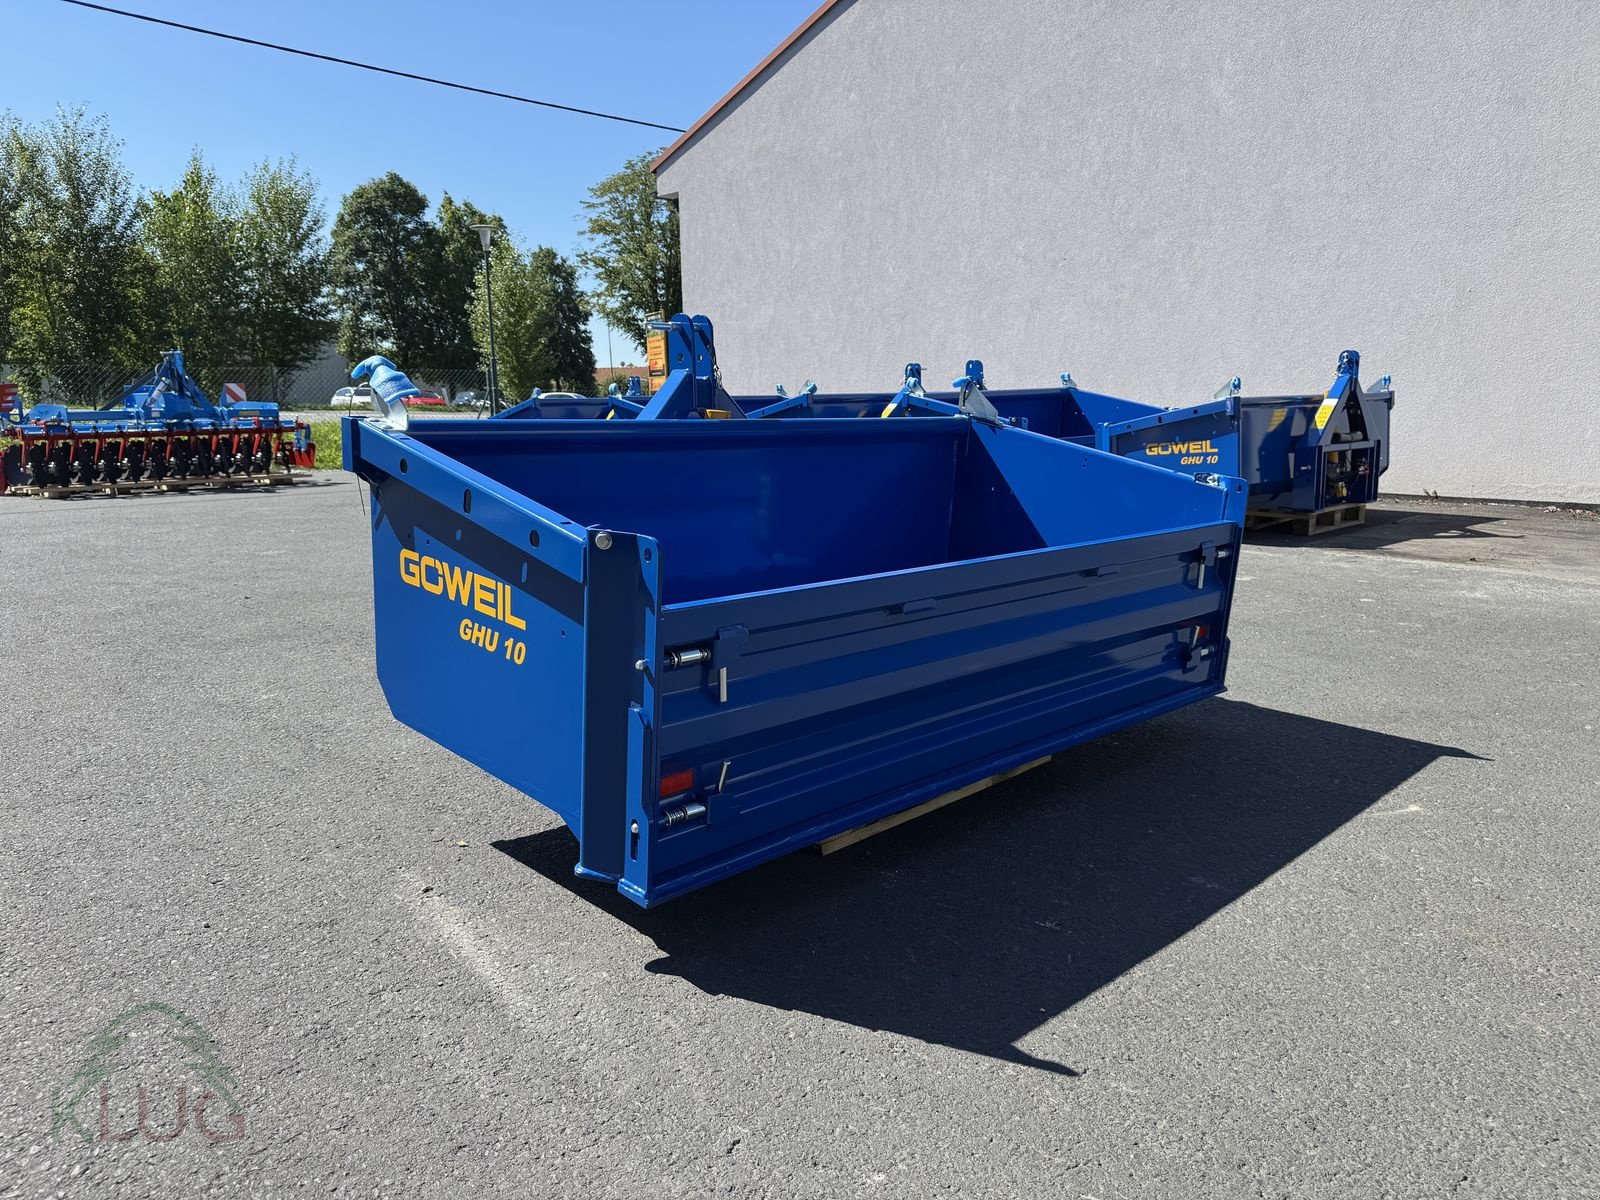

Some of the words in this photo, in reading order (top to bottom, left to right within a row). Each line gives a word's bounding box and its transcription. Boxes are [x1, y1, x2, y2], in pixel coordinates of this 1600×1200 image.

[1180, 456, 1204, 465] GHU
[1206, 455, 1219, 464] 10
[459, 618, 500, 653] GHU
[504, 637, 527, 665] 10
